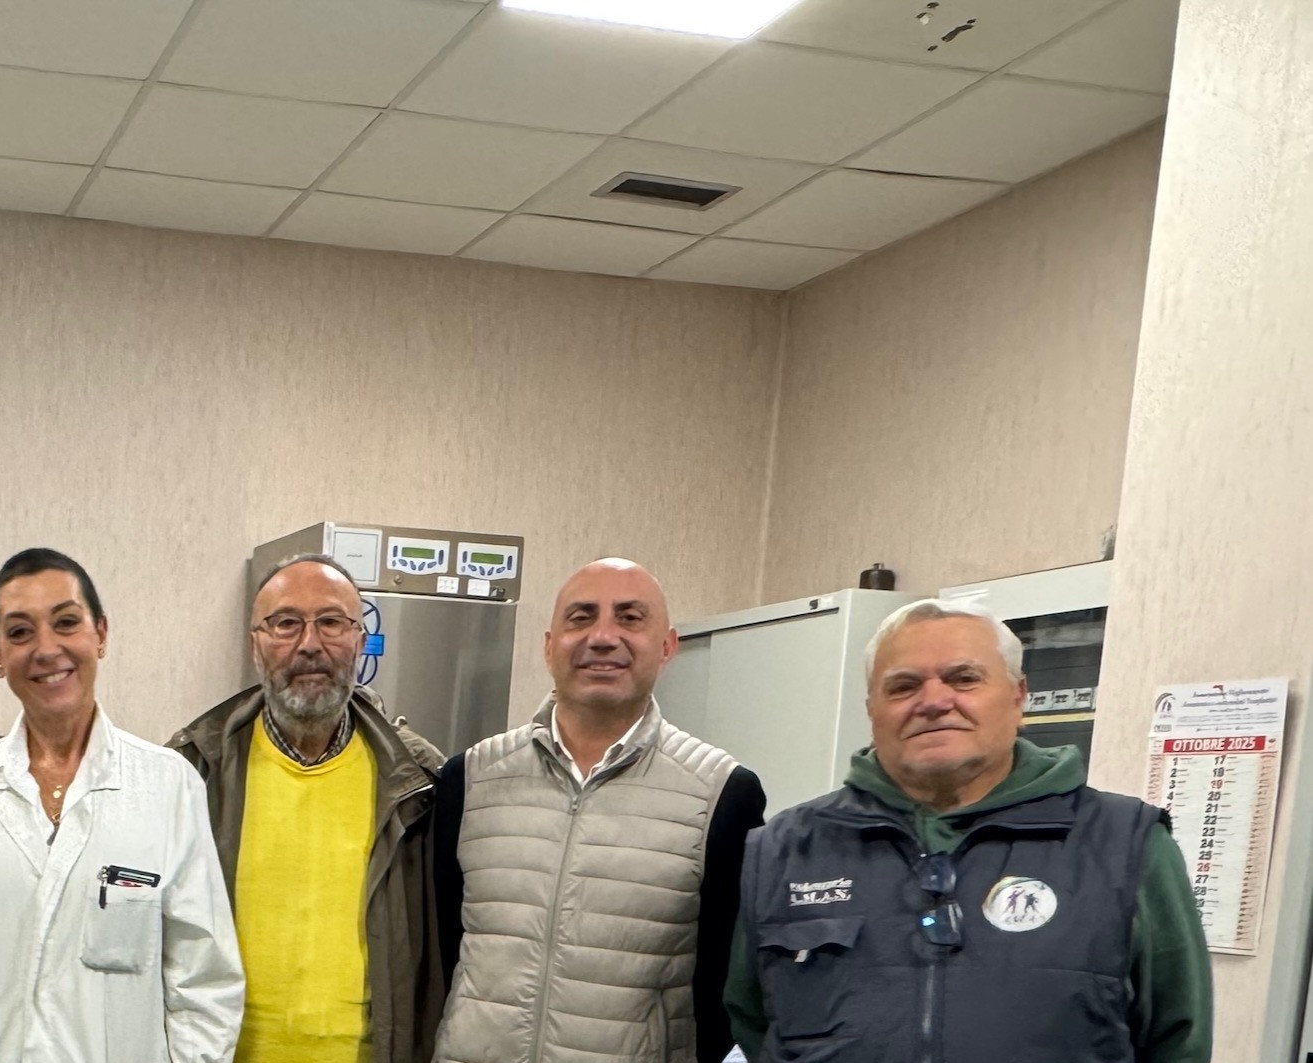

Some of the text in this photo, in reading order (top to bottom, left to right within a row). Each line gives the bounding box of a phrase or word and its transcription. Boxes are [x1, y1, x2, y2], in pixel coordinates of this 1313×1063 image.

[1172, 737, 1256, 751] OTTOBRE 2025
[1214, 755, 1226, 765] 17
[1170, 768, 1177, 778] 2
[1169, 780, 1176, 789] 3
[1205, 803, 1219, 813] 21
[1203, 815, 1217, 825] 22
[1202, 827, 1216, 837] 23
[1200, 839, 1214, 849] 24
[1198, 850, 1212, 860] 25
[1196, 862, 1211, 872] 26
[1195, 874, 1209, 884] 27
